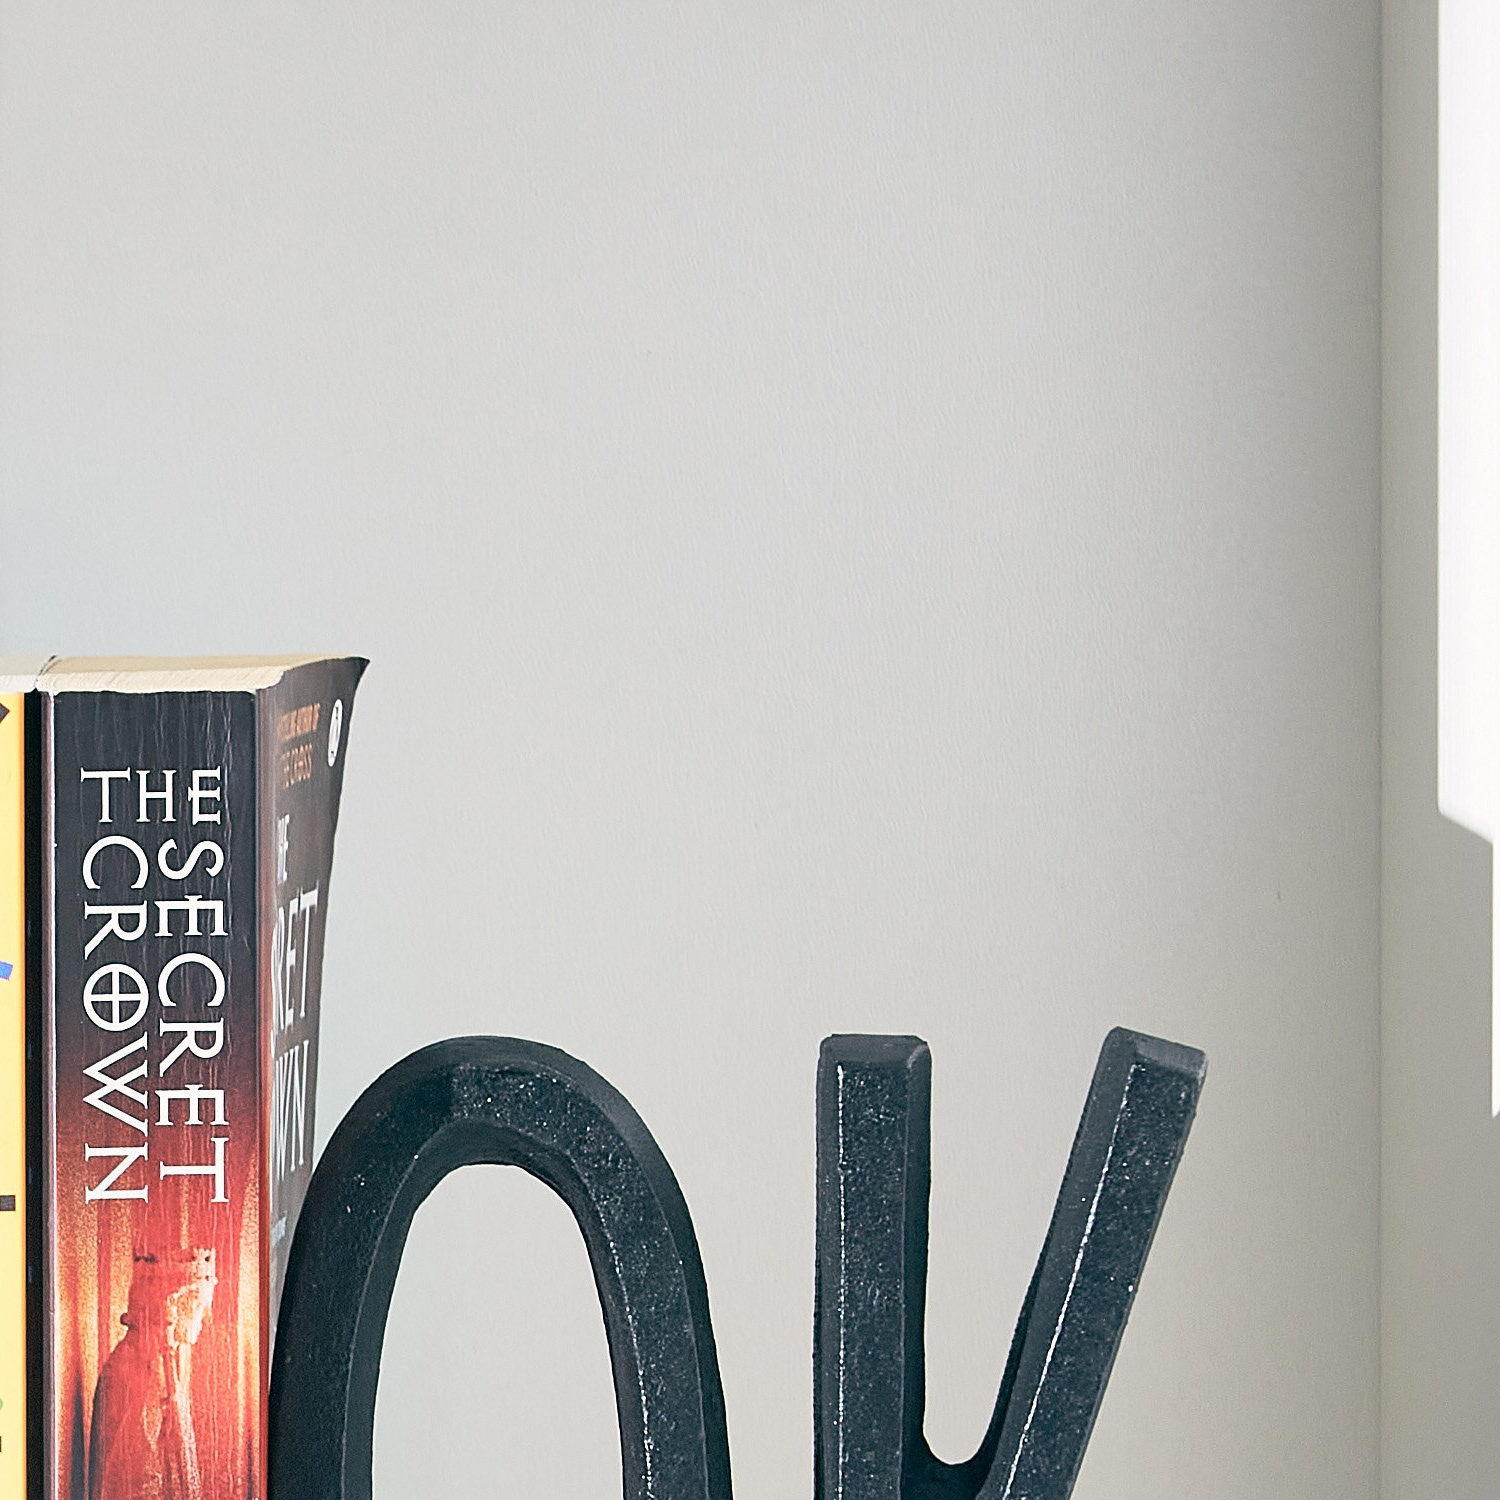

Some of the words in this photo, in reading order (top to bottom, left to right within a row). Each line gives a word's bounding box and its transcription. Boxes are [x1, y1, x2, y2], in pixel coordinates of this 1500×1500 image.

[80, 766, 222, 825] THE
[82, 836, 148, 1204] CROWN
[155, 838, 229, 1202] SECRET
